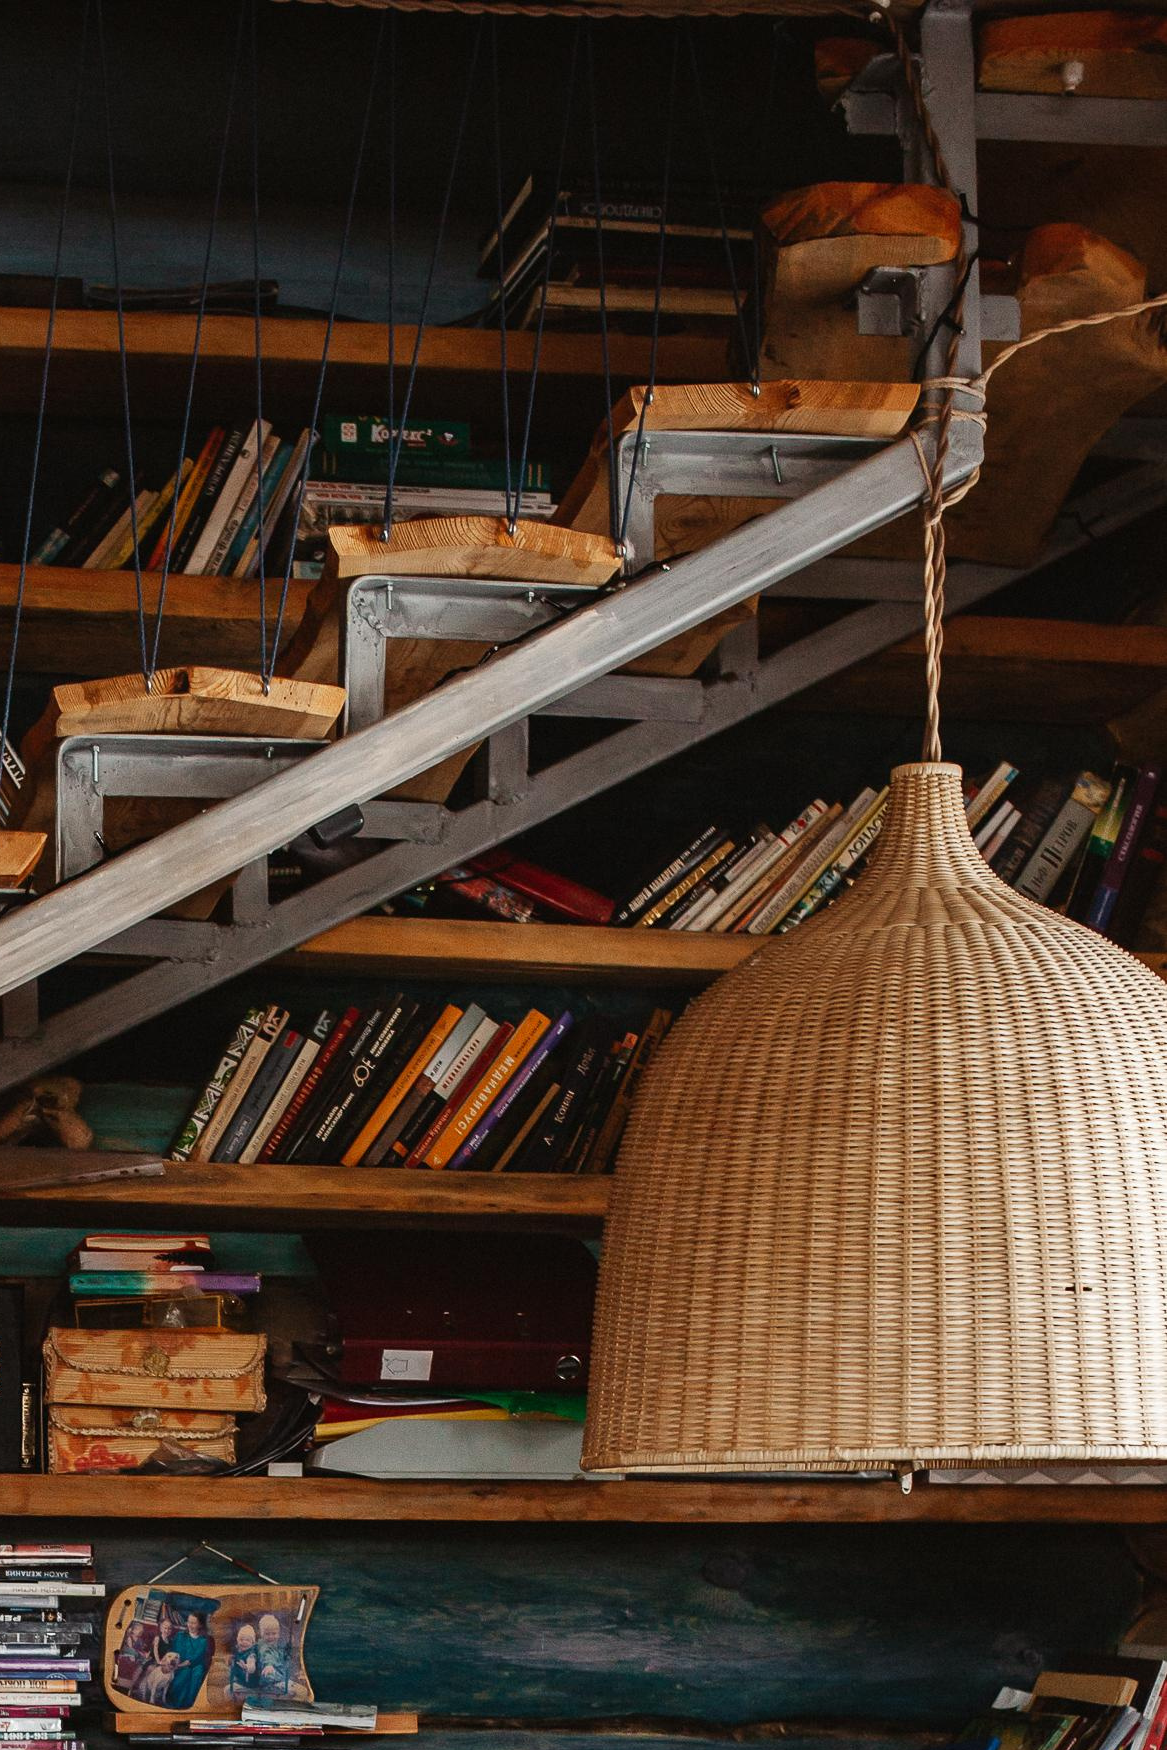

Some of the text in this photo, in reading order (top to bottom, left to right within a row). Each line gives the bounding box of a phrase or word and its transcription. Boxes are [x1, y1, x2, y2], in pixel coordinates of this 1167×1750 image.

[375, 1005, 403, 1043] СОВЕТСКОГО
[373, 1028, 396, 1058] ЧЕЛОВЕКА
[453, 1051, 516, 1137] МЕДИАВИРУС!
[550, 1087, 578, 1124] Конан
[319, 1108, 344, 1142] АЛЕКСАНДР
[5, 1569, 42, 1577] ЖЕЛАНИЯ
